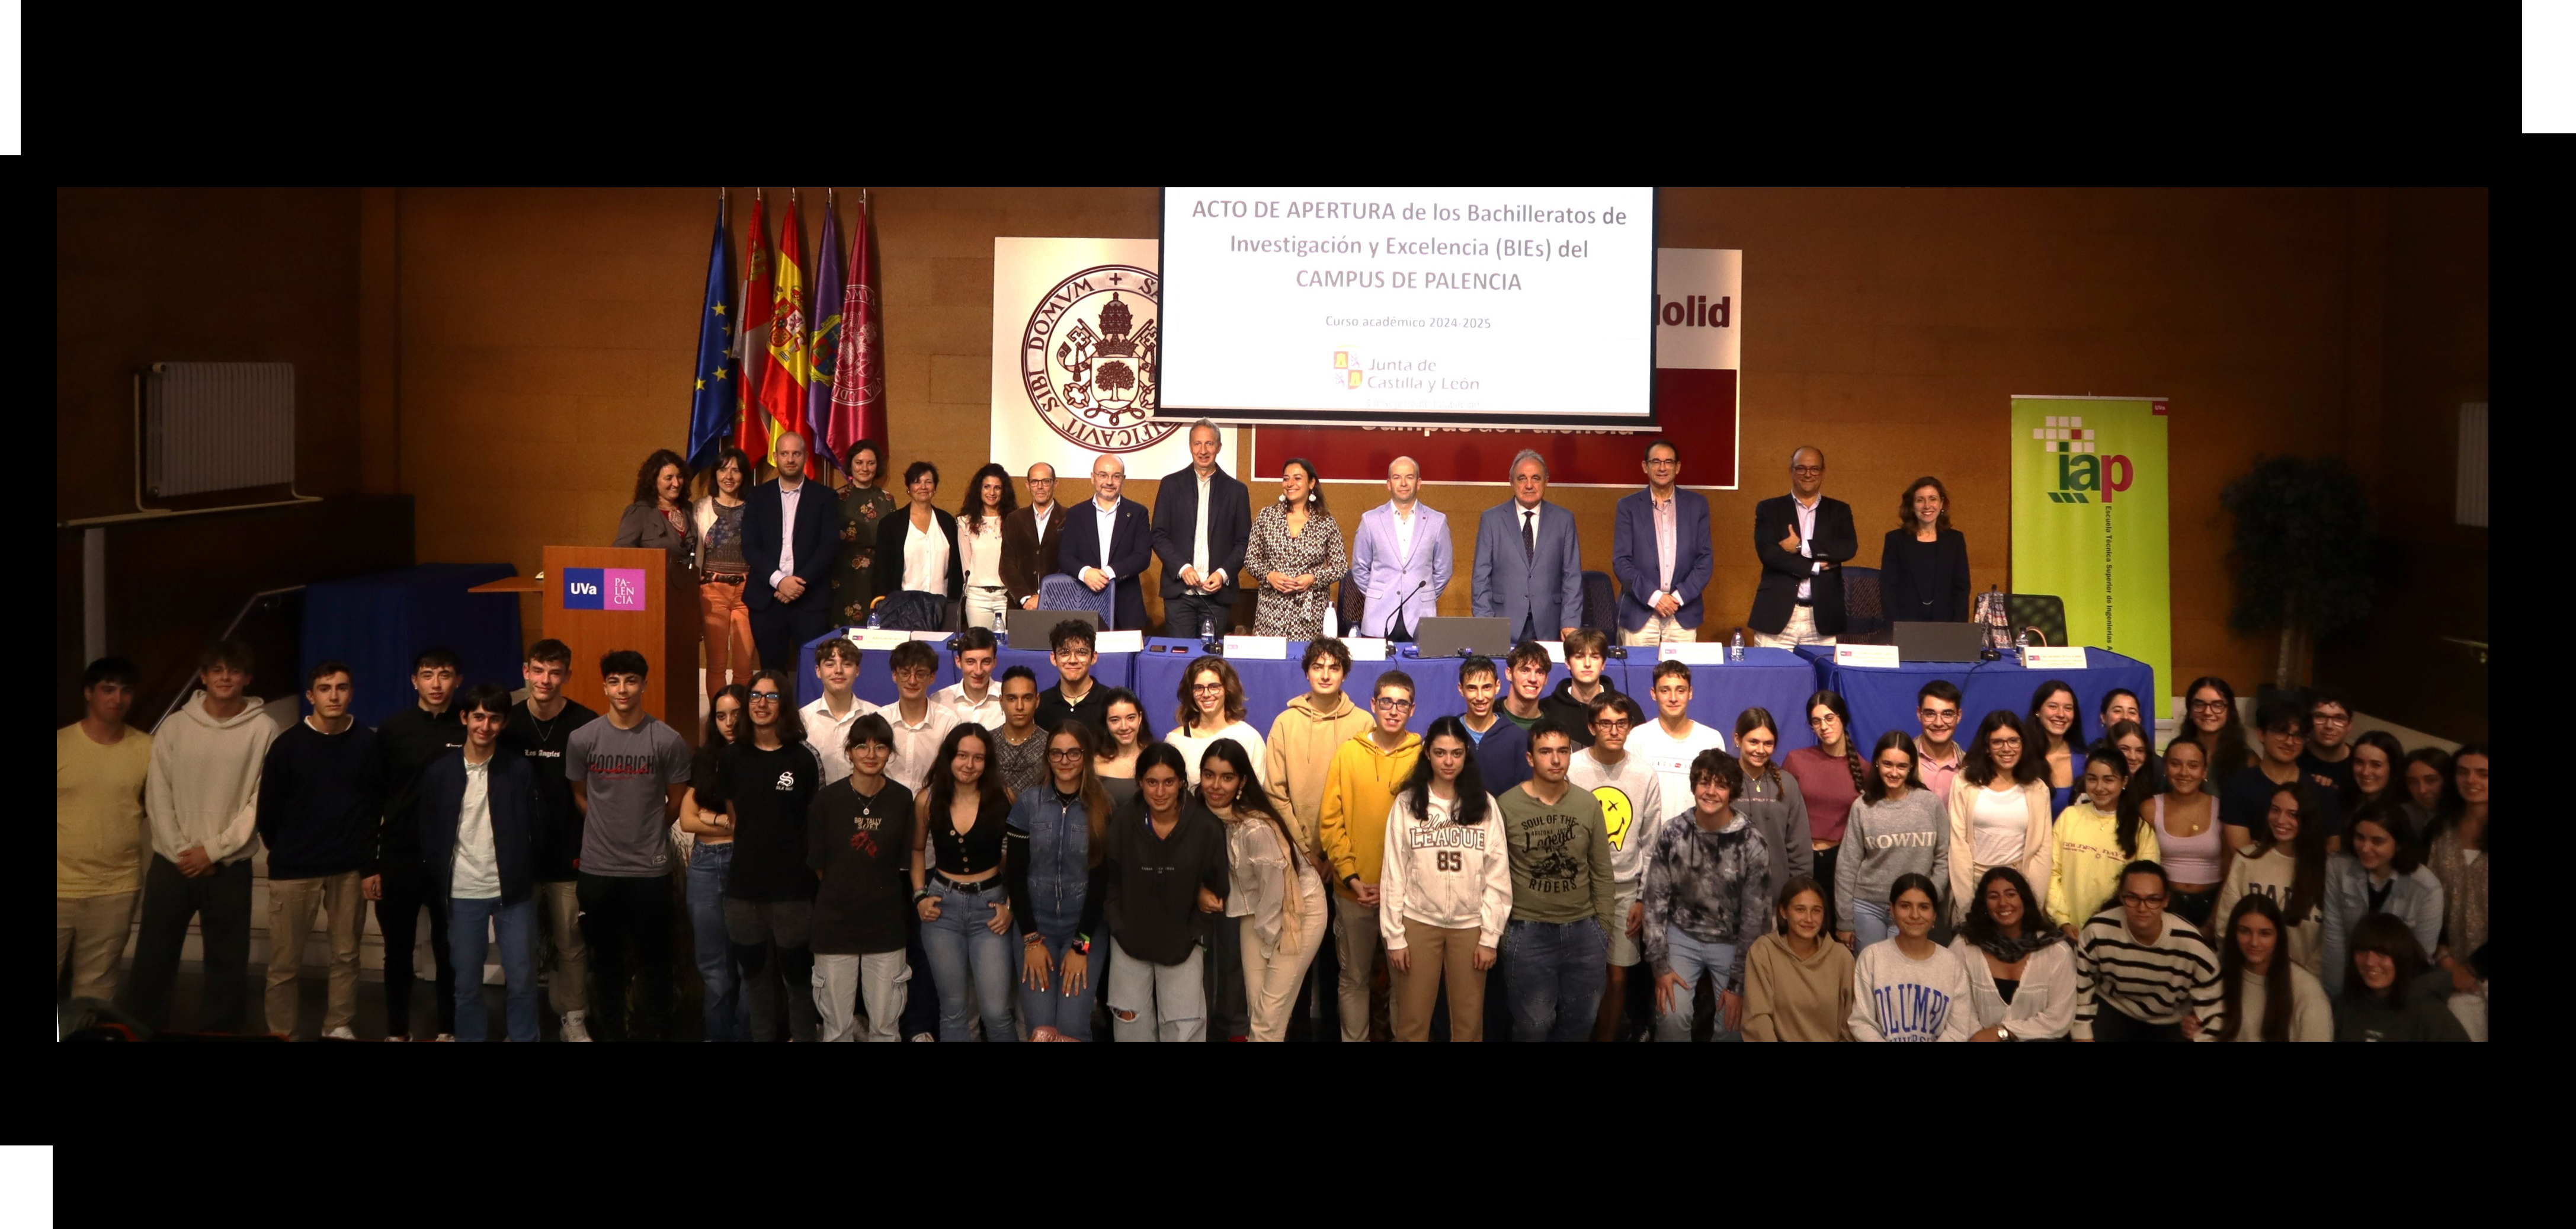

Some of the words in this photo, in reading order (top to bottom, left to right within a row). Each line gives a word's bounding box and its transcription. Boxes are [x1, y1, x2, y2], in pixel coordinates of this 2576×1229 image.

[1192, 200, 1247, 218] ACTO
[1255, 201, 1280, 218] DE
[1287, 201, 1395, 220] APERTURA
[1402, 203, 1426, 220] de
[1433, 203, 1460, 221] los
[1468, 204, 1595, 224] Bachilleratos
[1603, 207, 1626, 225] de
[1231, 235, 1361, 258] Investigación
[1369, 242, 1379, 258] y
[1386, 237, 1489, 255] Excelencia
[1496, 238, 1551, 261] (BIEs)
[1558, 239, 1588, 258] del
[1296, 270, 1385, 289] CAMPUS
[1392, 271, 1417, 289] DE
[1425, 272, 1522, 290] PALENCIA
[1029, 278, 1095, 351] DOMVM
[1657, 295, 1731, 328] olid
[1325, 316, 1359, 327] Curso
[1363, 316, 1425, 328] académico
[1430, 318, 1491, 328] 2024-2025
[1368, 359, 1412, 371] Junta
[1418, 359, 1437, 372] de
[1029, 369, 1060, 412] SIBI
[1367, 376, 1422, 389] Castilla
[1427, 379, 1436, 393] y
[1442, 377, 1480, 390] León
[2059, 441, 2133, 503] iap
[571, 583, 597, 595] UVa
[614, 578, 630, 587] PA-
[614, 596, 633, 604] CIA
[615, 587, 635, 596] LEN
[2106, 595, 2113, 604] de
[539, 749, 560, 758] Angeles
[1521, 816, 1545, 830] SOUL
[1547, 815, 1558, 824] OF
[1561, 815, 1577, 827] THE
[1409, 827, 1485, 851] LEAGUE
[1522, 823, 1579, 853] Legend
[1437, 850, 1462, 872] 85
[1529, 878, 1577, 893] RIDERS
